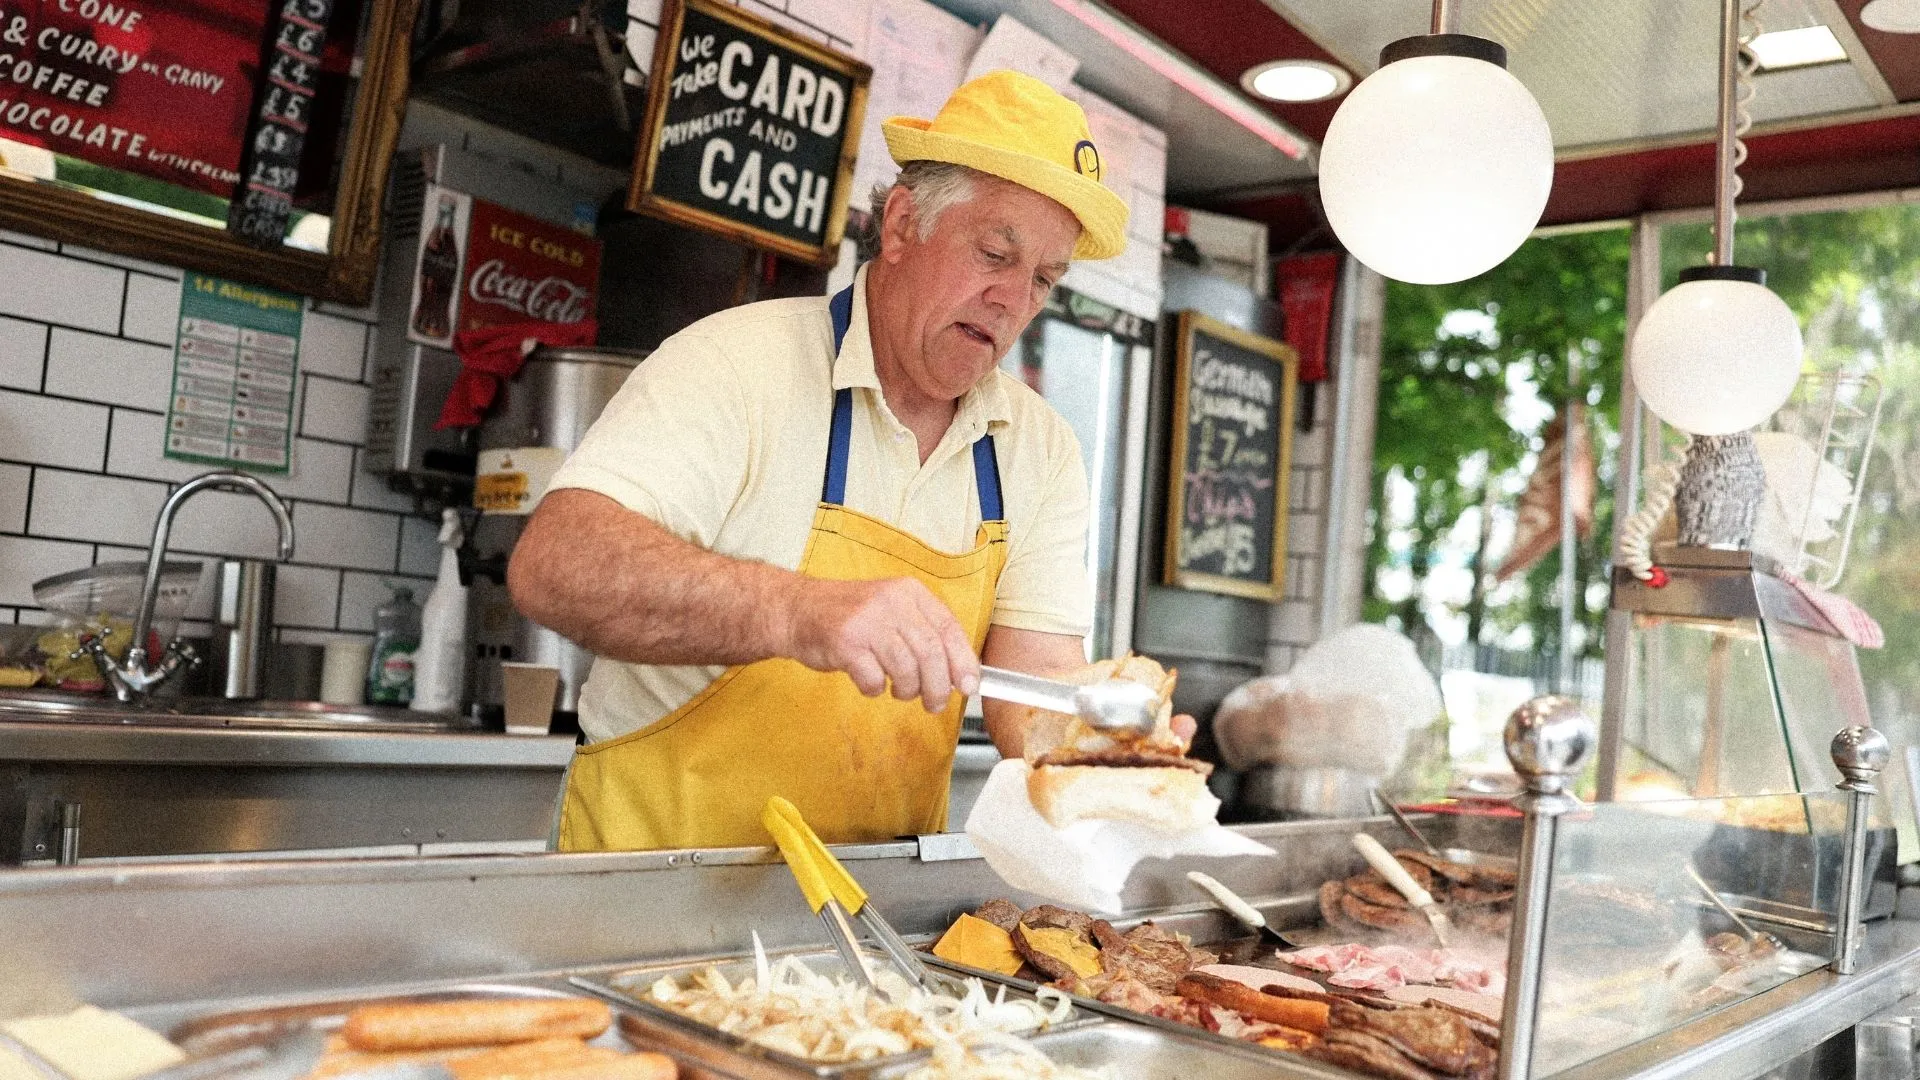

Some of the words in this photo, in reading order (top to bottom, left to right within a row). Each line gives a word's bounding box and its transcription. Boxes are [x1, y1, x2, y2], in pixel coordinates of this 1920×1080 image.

[59, 0, 142, 33] CONE
[3, 16, 30, 46] &
[37, 27, 139, 74] CURRY
[164, 64, 224, 95] GRAVY
[270, 54, 310, 84] £4
[0, 53, 110, 107] COFFEE
[671, 61, 718, 99] Take
[717, 41, 844, 137] CARD
[659, 106, 747, 151] PAYMENTS
[749, 118, 797, 152] AND
[700, 137, 829, 233] CASH
[489, 223, 525, 249] ICE
[529, 236, 585, 268] COLD
[194, 275, 215, 294] 14
